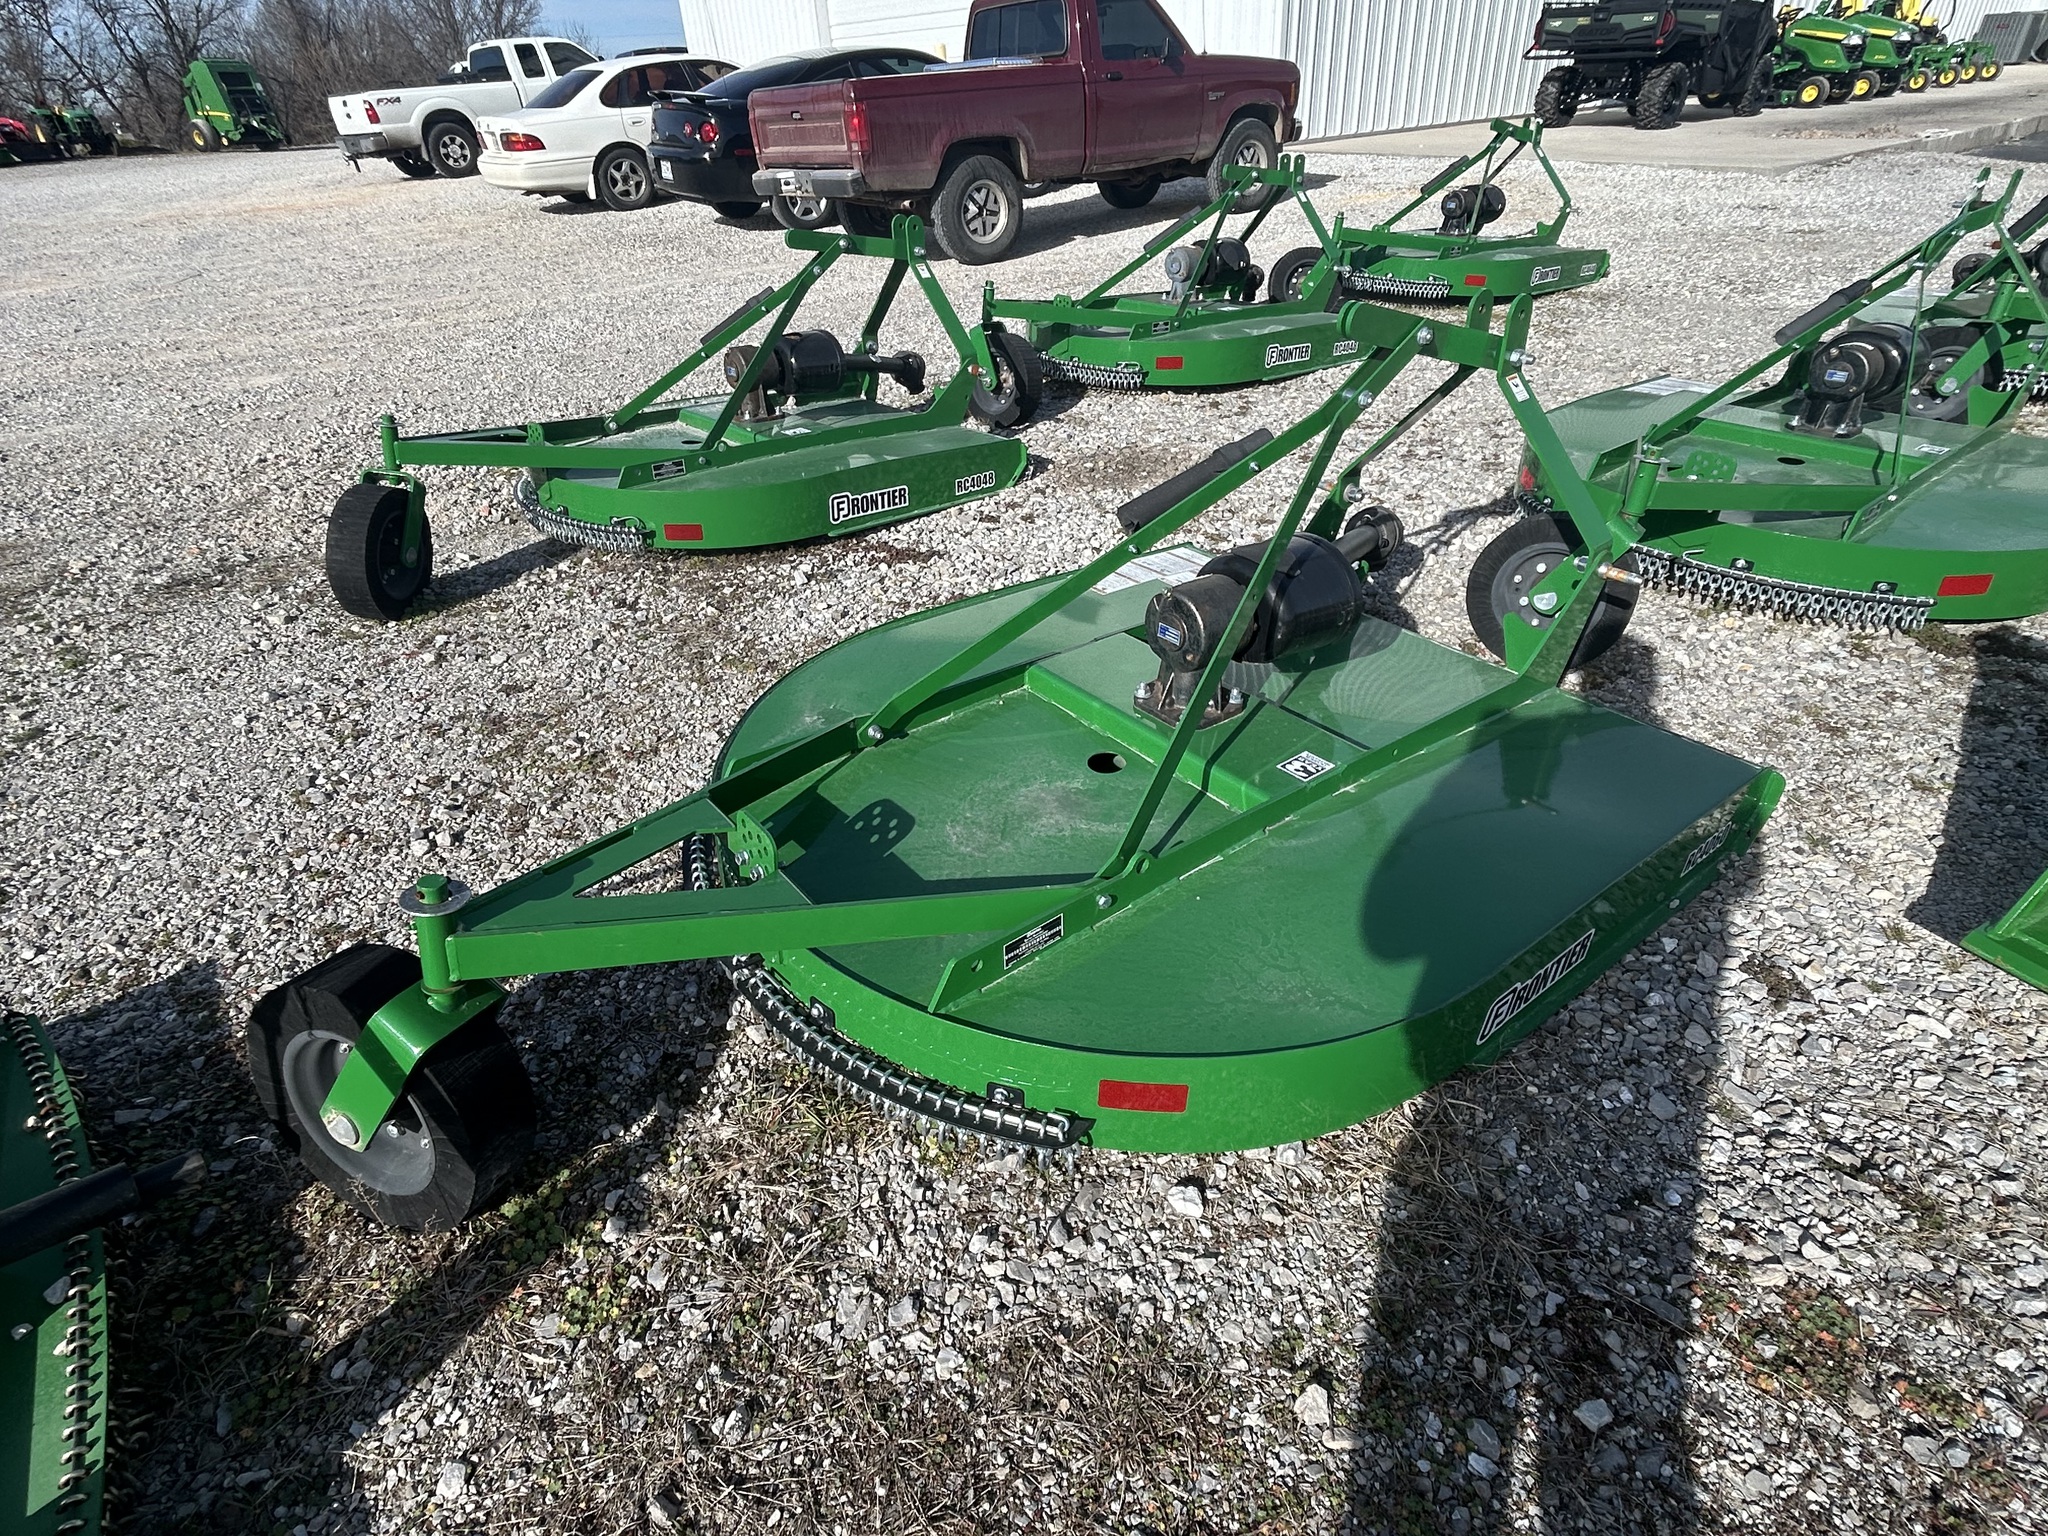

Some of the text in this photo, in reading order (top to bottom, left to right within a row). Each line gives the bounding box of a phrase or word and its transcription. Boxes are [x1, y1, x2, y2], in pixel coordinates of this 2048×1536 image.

[377, 96, 401, 106] FX4
[1266, 344, 1311, 367] FRONTIER
[956, 472, 994, 494] RC4048
[831, 487, 907, 522] FRONTIER
[1477, 929, 1595, 1043] FRONTIER
